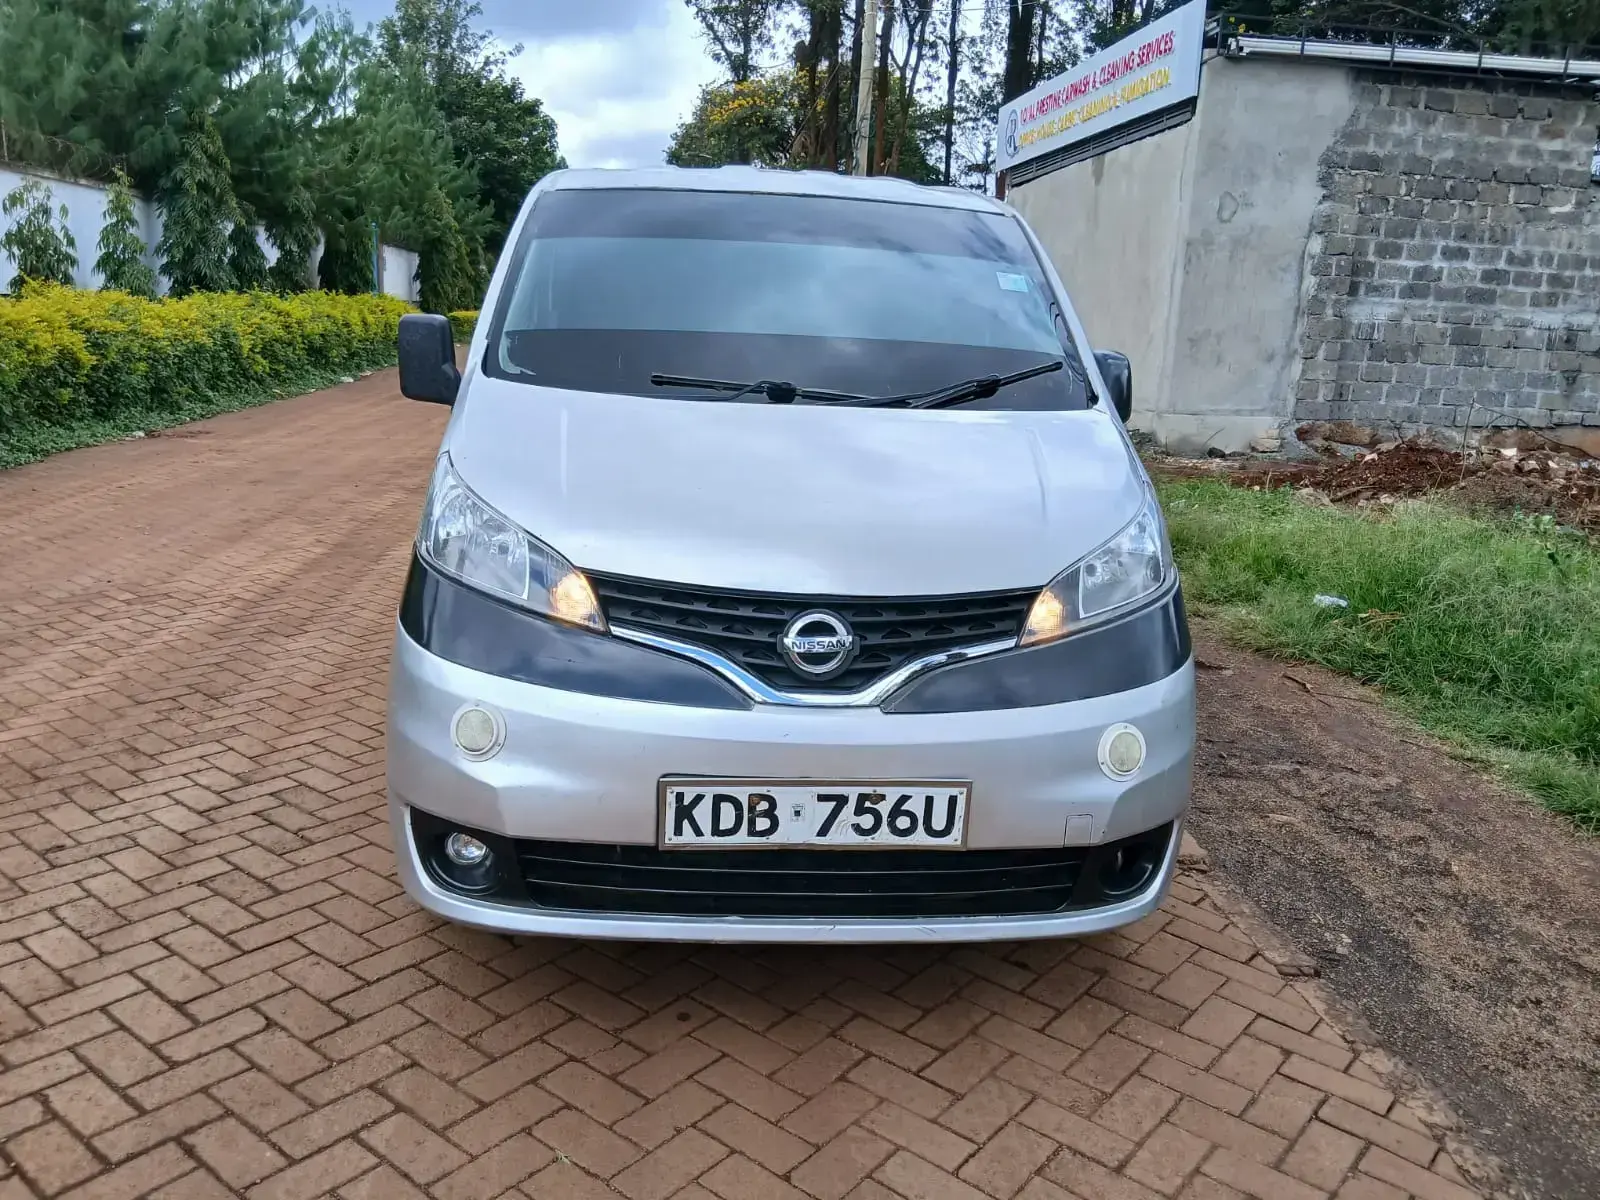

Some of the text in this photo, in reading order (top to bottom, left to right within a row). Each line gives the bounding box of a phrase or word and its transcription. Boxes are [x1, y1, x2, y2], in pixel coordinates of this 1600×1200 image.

[1062, 73, 1090, 104] CARWASH
[1092, 71, 1098, 89] &
[1100, 50, 1135, 85] CLEANING
[1137, 30, 1174, 67] SERVICES
[791, 640, 846, 650] NISSAN
[673, 791, 780, 838] KDB
[815, 792, 958, 839] 756U
